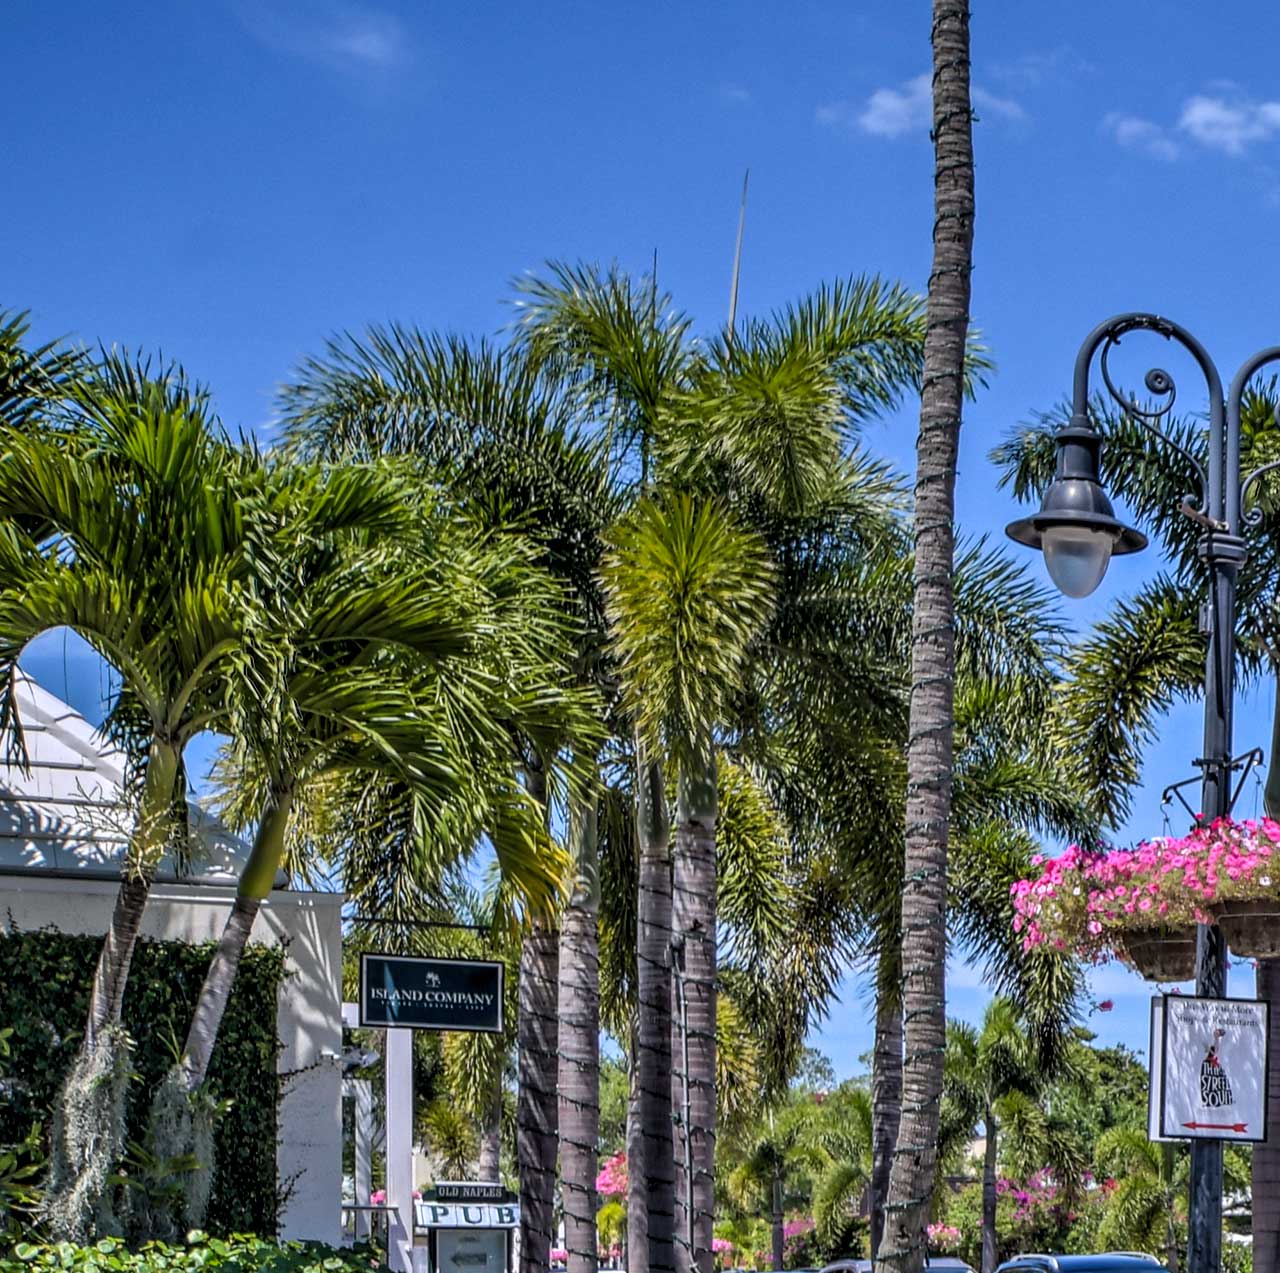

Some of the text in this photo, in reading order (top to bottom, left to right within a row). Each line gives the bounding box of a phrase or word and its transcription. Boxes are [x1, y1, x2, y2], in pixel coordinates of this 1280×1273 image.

[370, 987, 423, 1001] ISLAND
[425, 990, 494, 1006] COMPANY
[438, 1183, 503, 1199] OLD NAPLES
[430, 1204, 517, 1225] PUB
